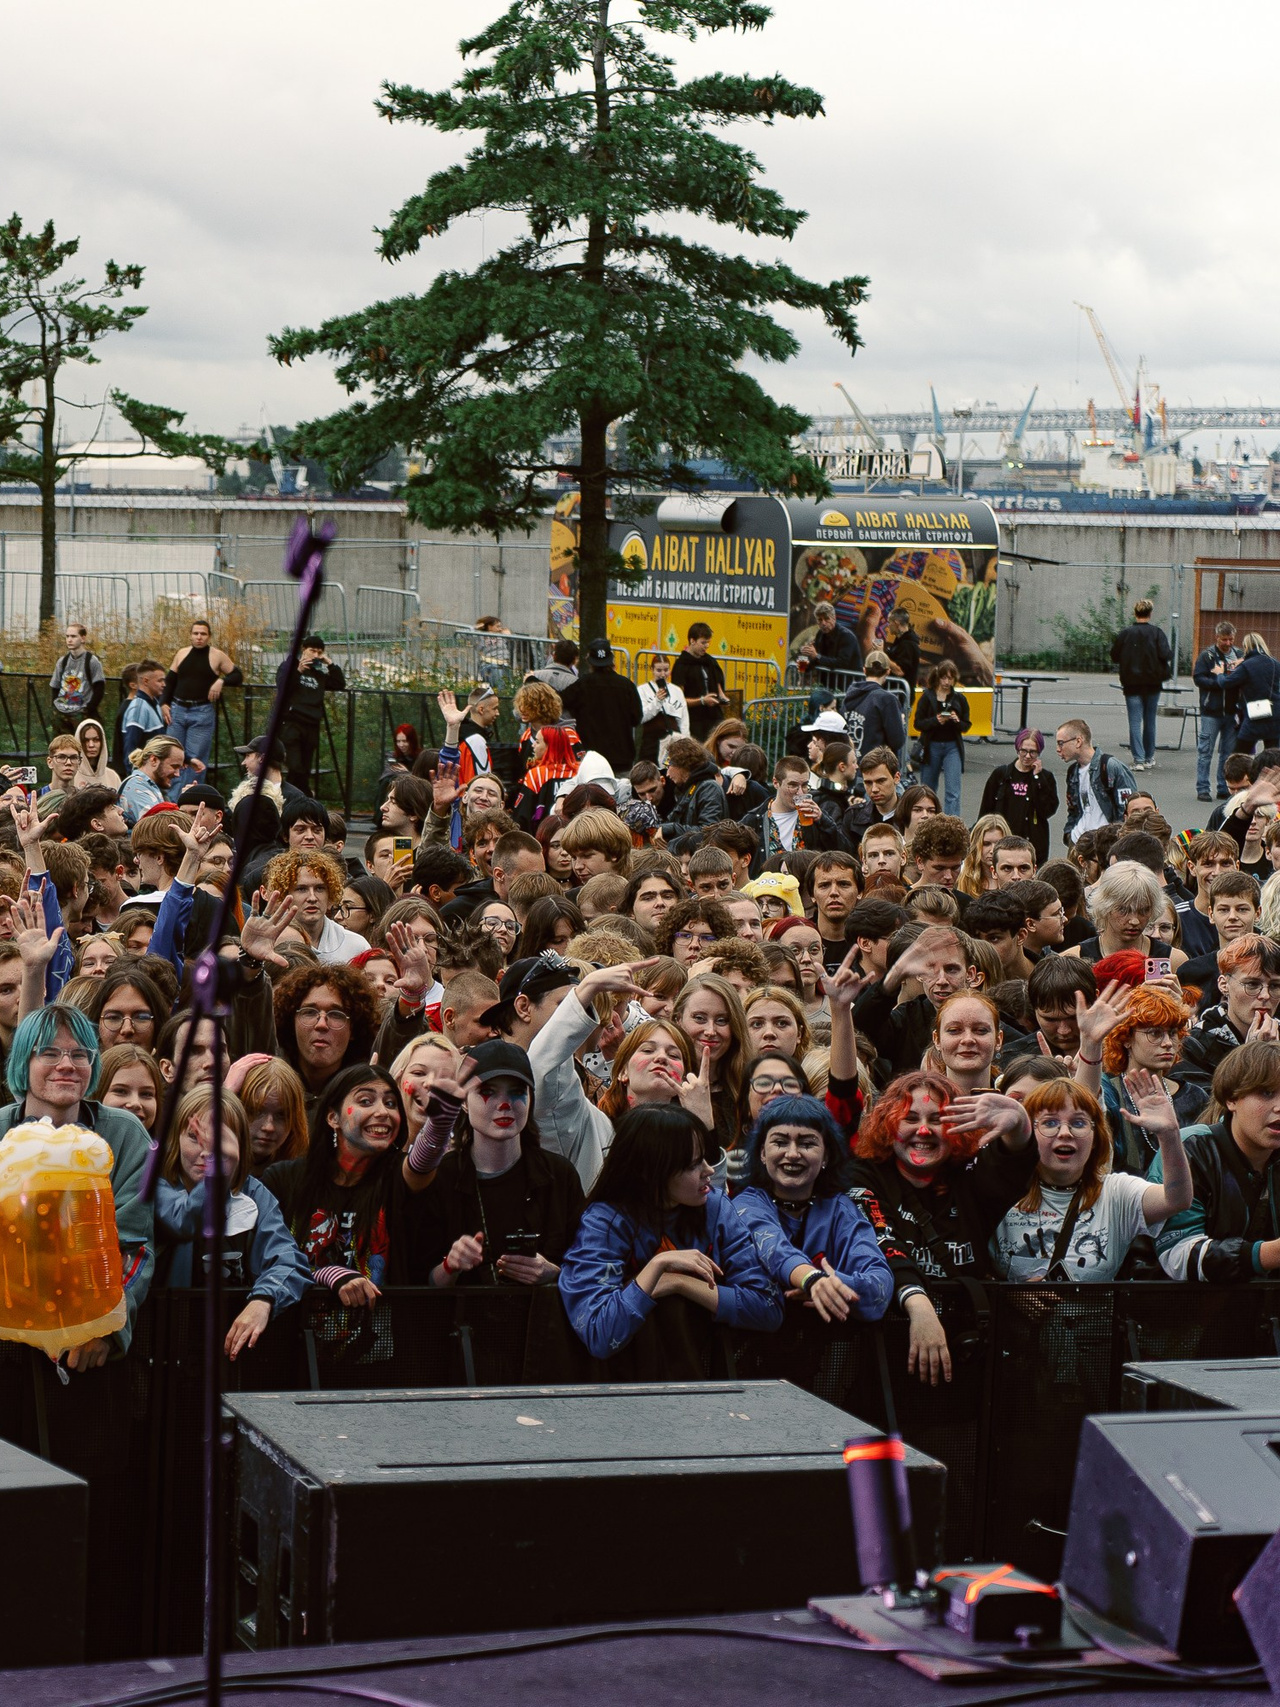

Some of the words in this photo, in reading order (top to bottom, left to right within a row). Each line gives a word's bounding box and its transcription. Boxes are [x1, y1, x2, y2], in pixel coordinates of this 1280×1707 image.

[963, 491, 1062, 512] arriers
[855, 510, 898, 528] AIBAT
[904, 511, 971, 530] HALLYAR
[816, 527, 854, 540] ПЕРВЫЙ
[858, 529, 921, 542] БАШКИРСКИЙ
[926, 531, 974, 544] СТРИТФУД
[651, 534, 700, 573] AIBAT
[705, 536, 776, 578] HALLYAR
[655, 579, 721, 603] БАШКИРСКИЙ
[723, 584, 775, 609] СТРИТФУД
